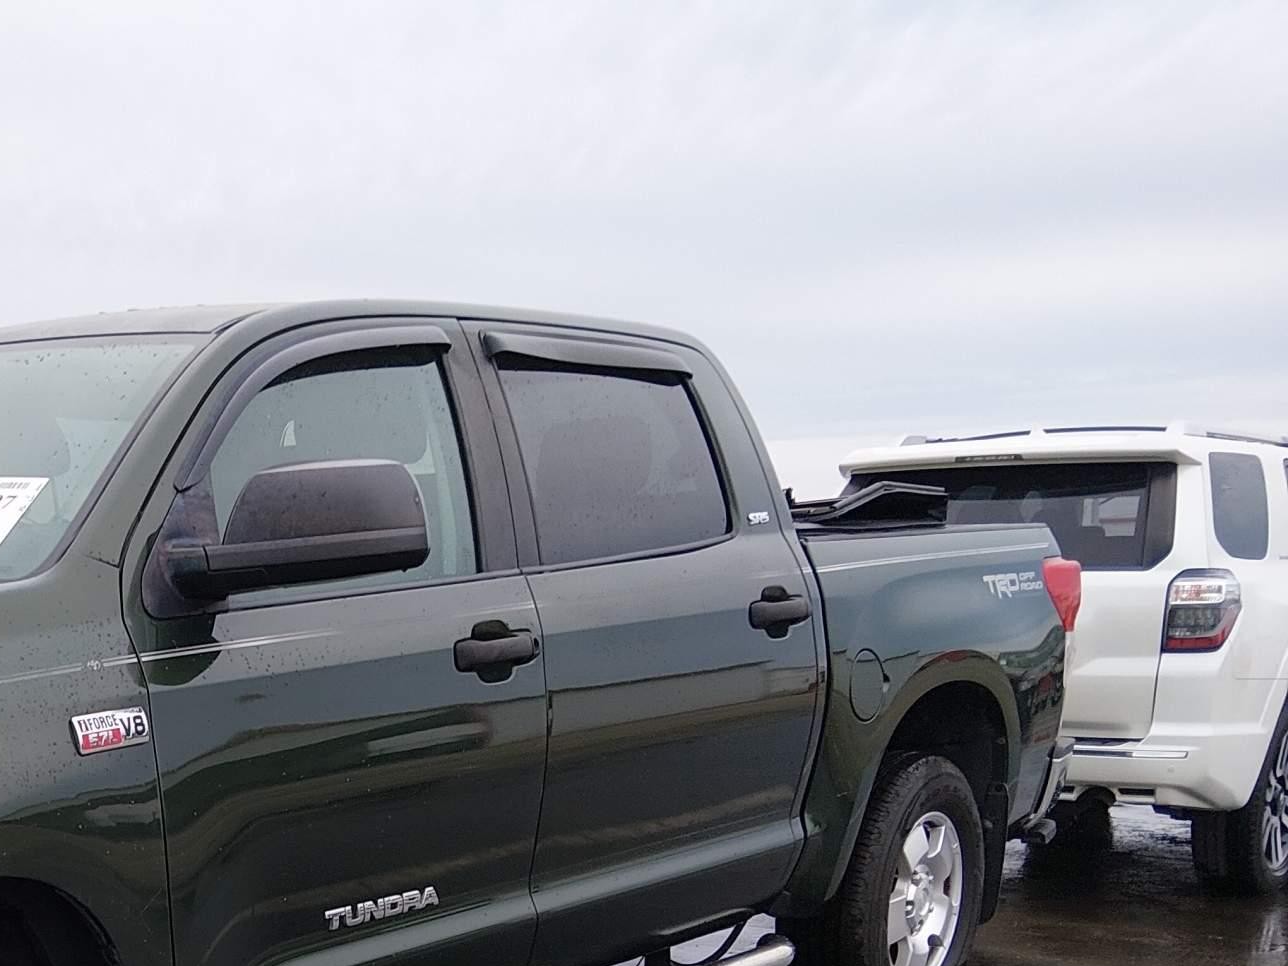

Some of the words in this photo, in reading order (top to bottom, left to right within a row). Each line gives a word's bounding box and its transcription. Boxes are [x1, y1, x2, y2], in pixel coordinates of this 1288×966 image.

[982, 572, 1020, 599] TRD
[1018, 571, 1036, 581] OFF
[1020, 580, 1044, 591] ROAD
[119, 714, 146, 737] V8
[324, 886, 440, 931] TUNDRA
